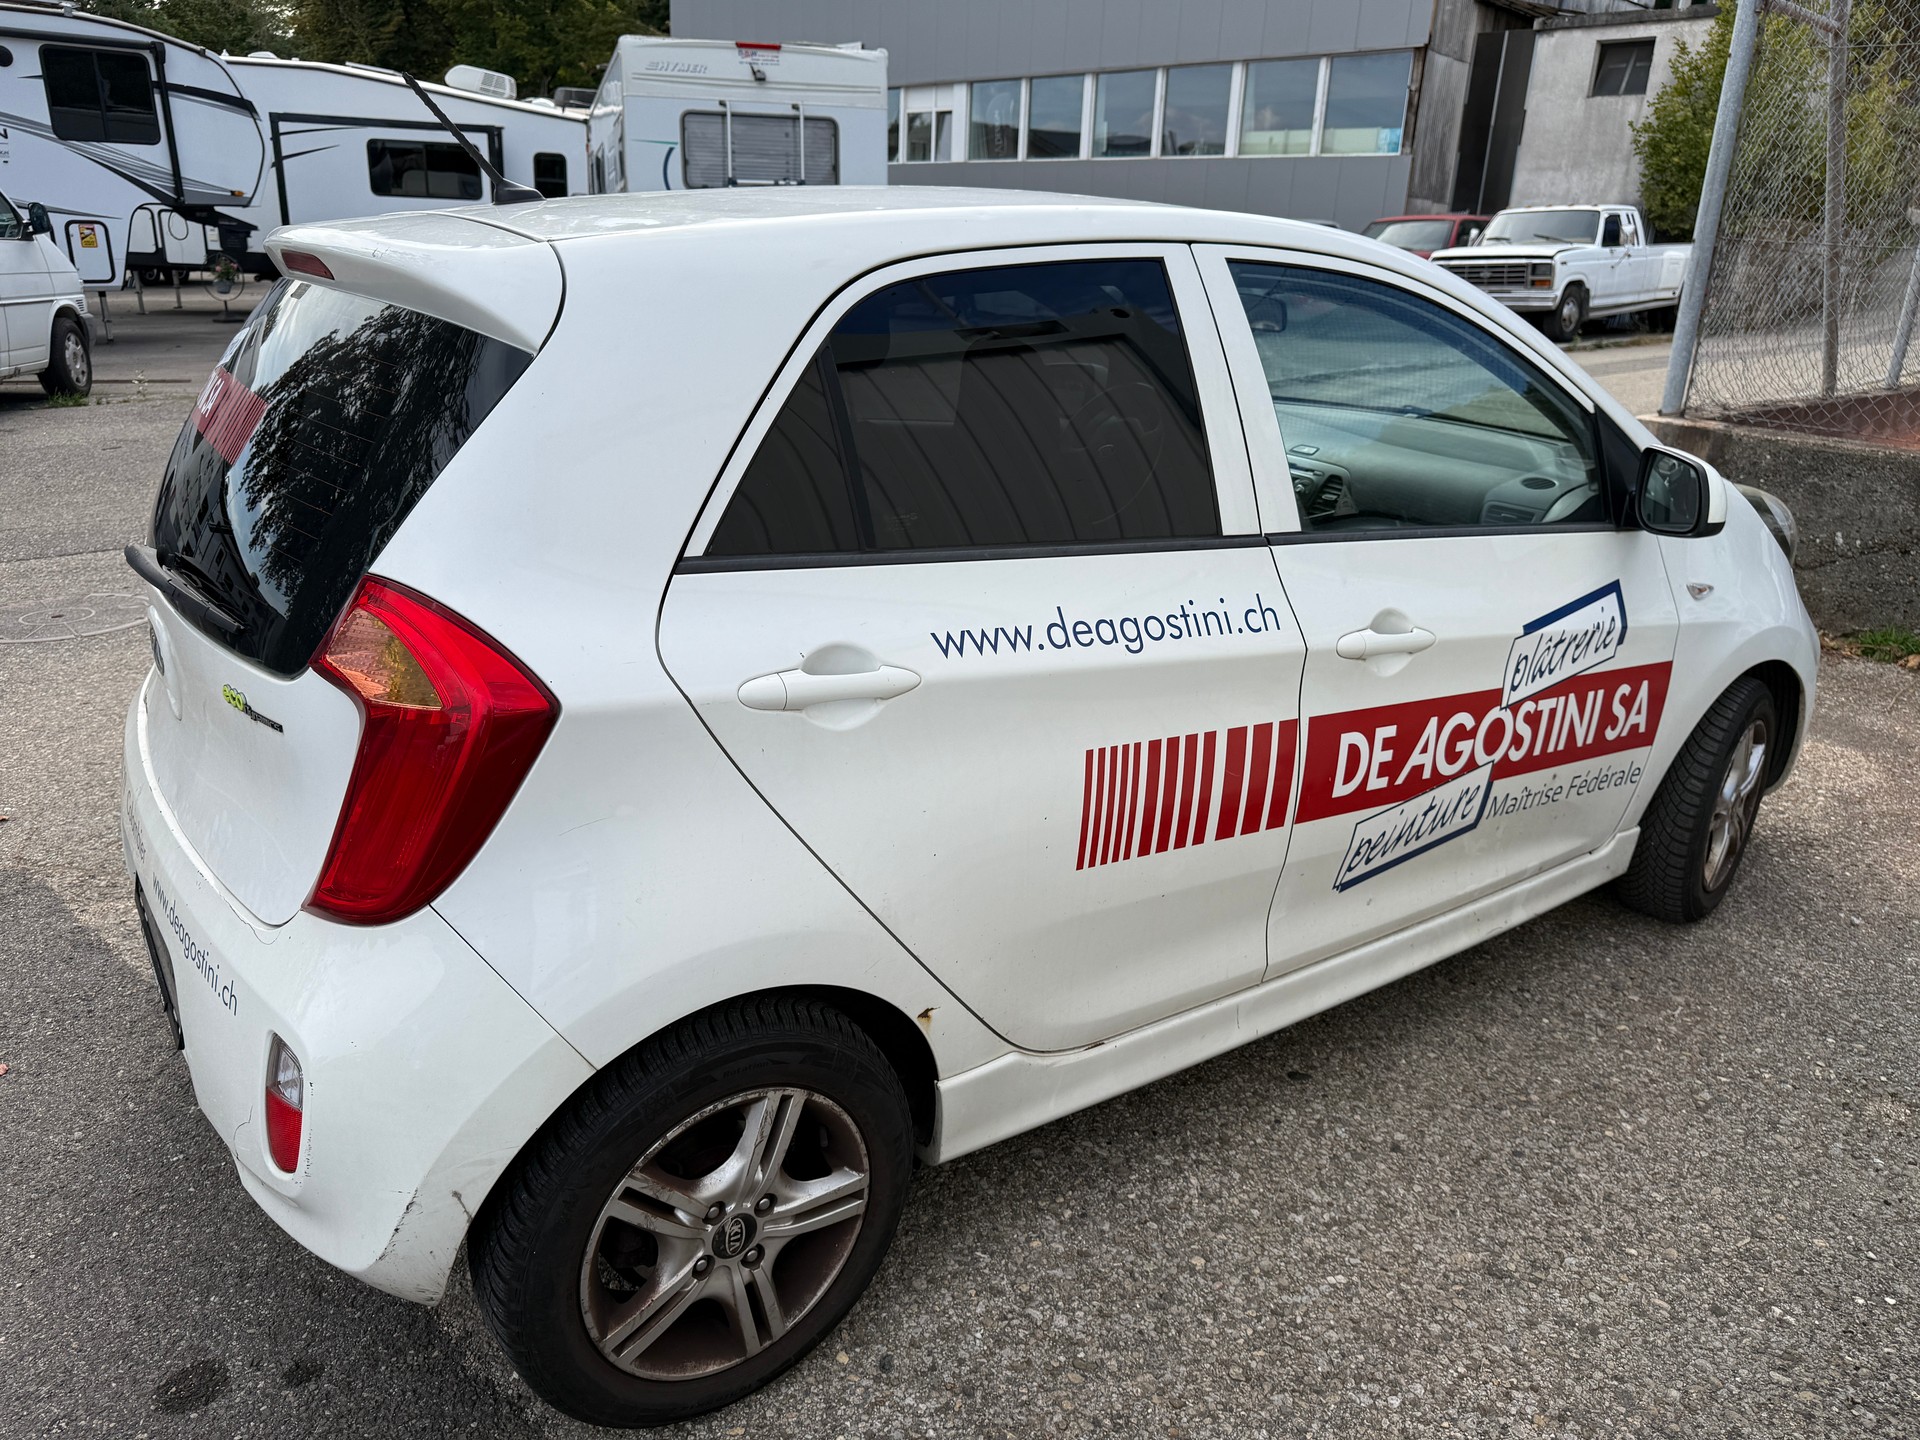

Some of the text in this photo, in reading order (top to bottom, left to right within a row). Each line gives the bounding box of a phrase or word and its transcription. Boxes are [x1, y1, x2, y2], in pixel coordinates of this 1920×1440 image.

[645, 61, 708, 74] HYMER
[930, 593, 1281, 659] www.deagostini.ch
[1509, 605, 1617, 693] plâtrerie
[222, 684, 247, 712] eco
[1332, 679, 1648, 798] DE AGOSTINI SA
[1348, 781, 1481, 873] peinture
[1486, 761, 1642, 820] Maîtrise Fédérale
[152, 872, 238, 1016] www.deagostini.ch
